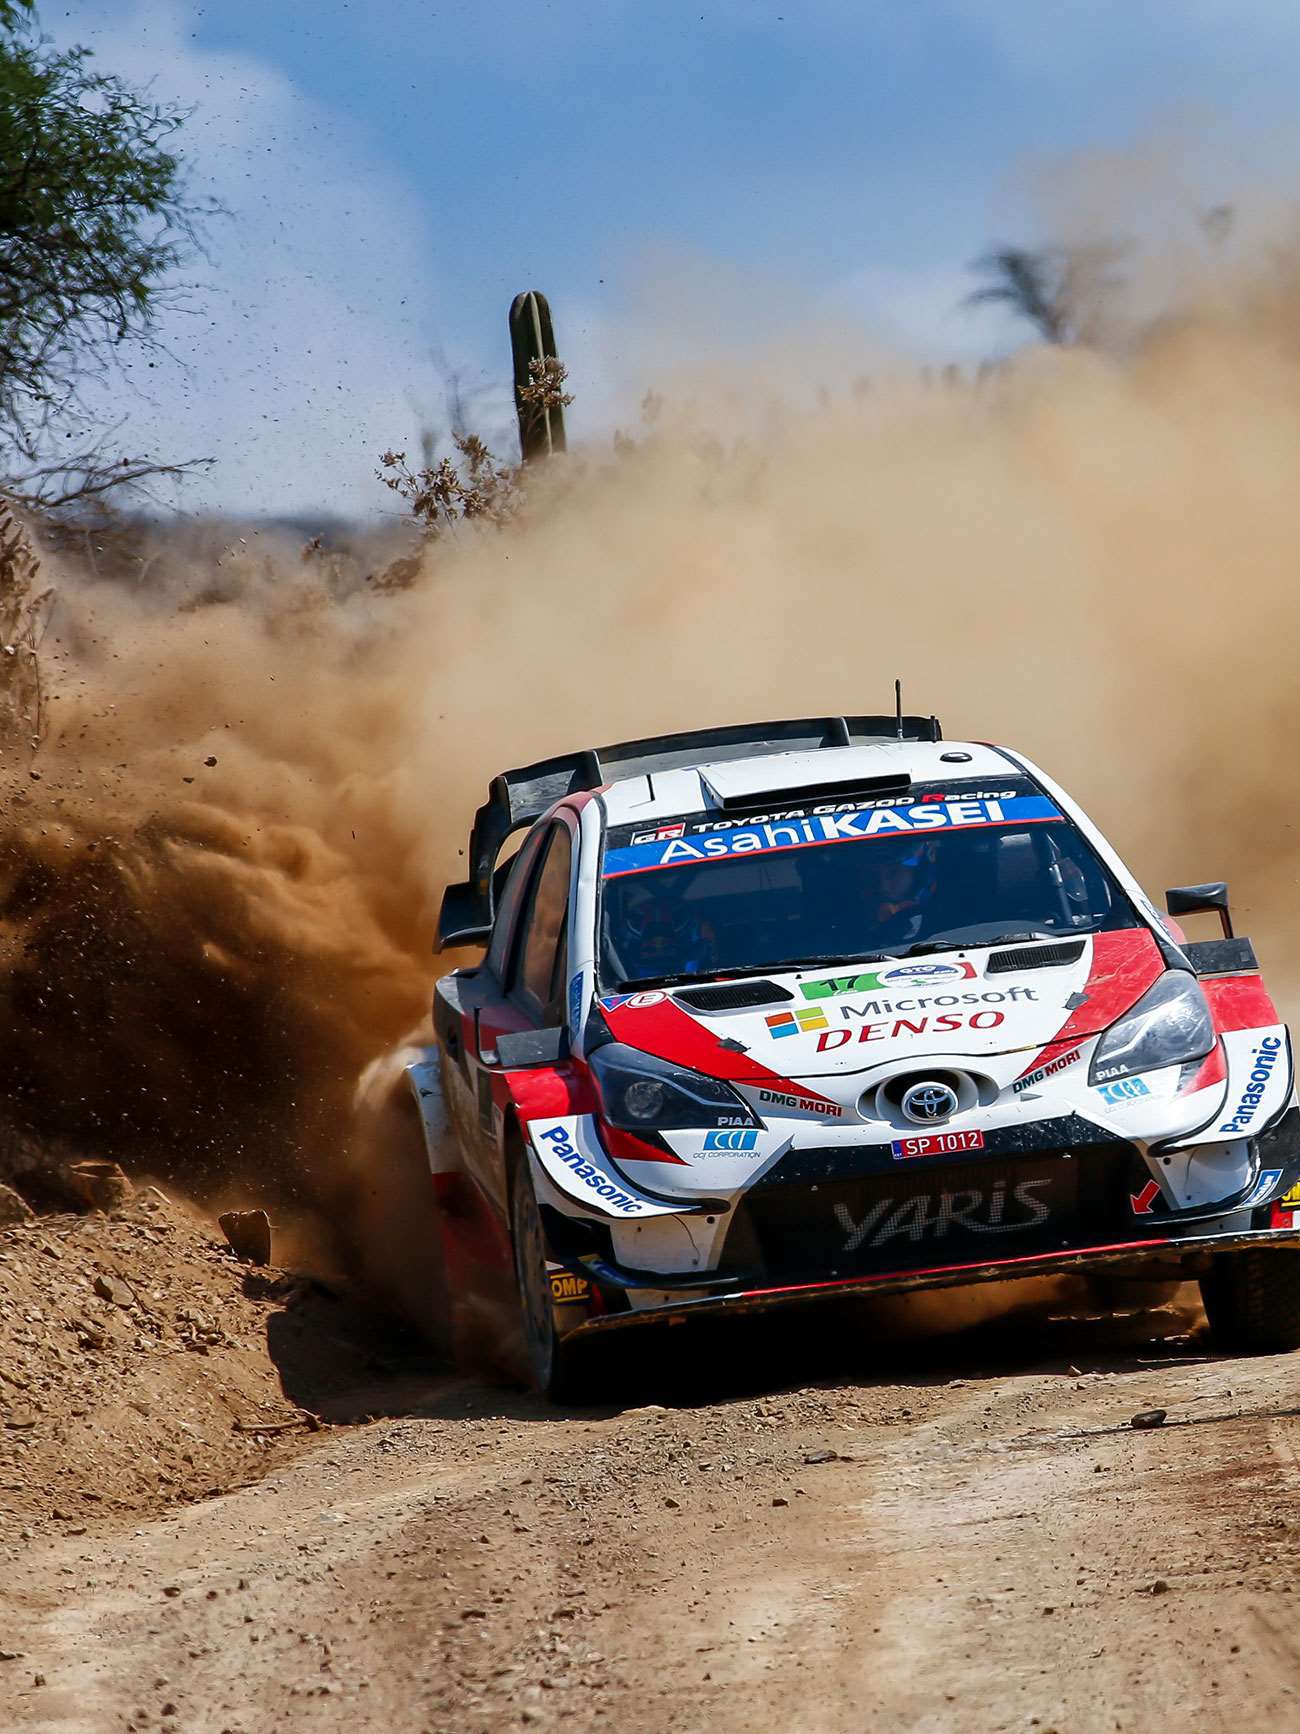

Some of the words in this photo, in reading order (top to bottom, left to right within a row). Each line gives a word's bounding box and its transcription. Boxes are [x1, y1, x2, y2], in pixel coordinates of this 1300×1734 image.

[693, 809, 805, 832] TOYOTA
[812, 796, 915, 814] GAZOO
[922, 790, 1017, 803] Racing
[819, 975, 860, 991] 17
[840, 986, 1039, 1020] Microsoft
[816, 1010, 1005, 1053] DENSO
[1012, 1070, 1044, 1094] DMG
[1044, 1049, 1081, 1077] MORI
[1095, 1064, 1129, 1081] PIAA
[1219, 1037, 1282, 1133] Panasonic
[759, 1089, 797, 1107] DMG
[799, 1098, 842, 1117] MORI
[717, 1116, 754, 1126] PIAA
[708, 1151, 761, 1160] CORPORATION
[906, 1138, 930, 1155] SP
[936, 1132, 979, 1151] 1012
[539, 1125, 642, 1213] Panasonic
[551, 1278, 588, 1297] OMP
